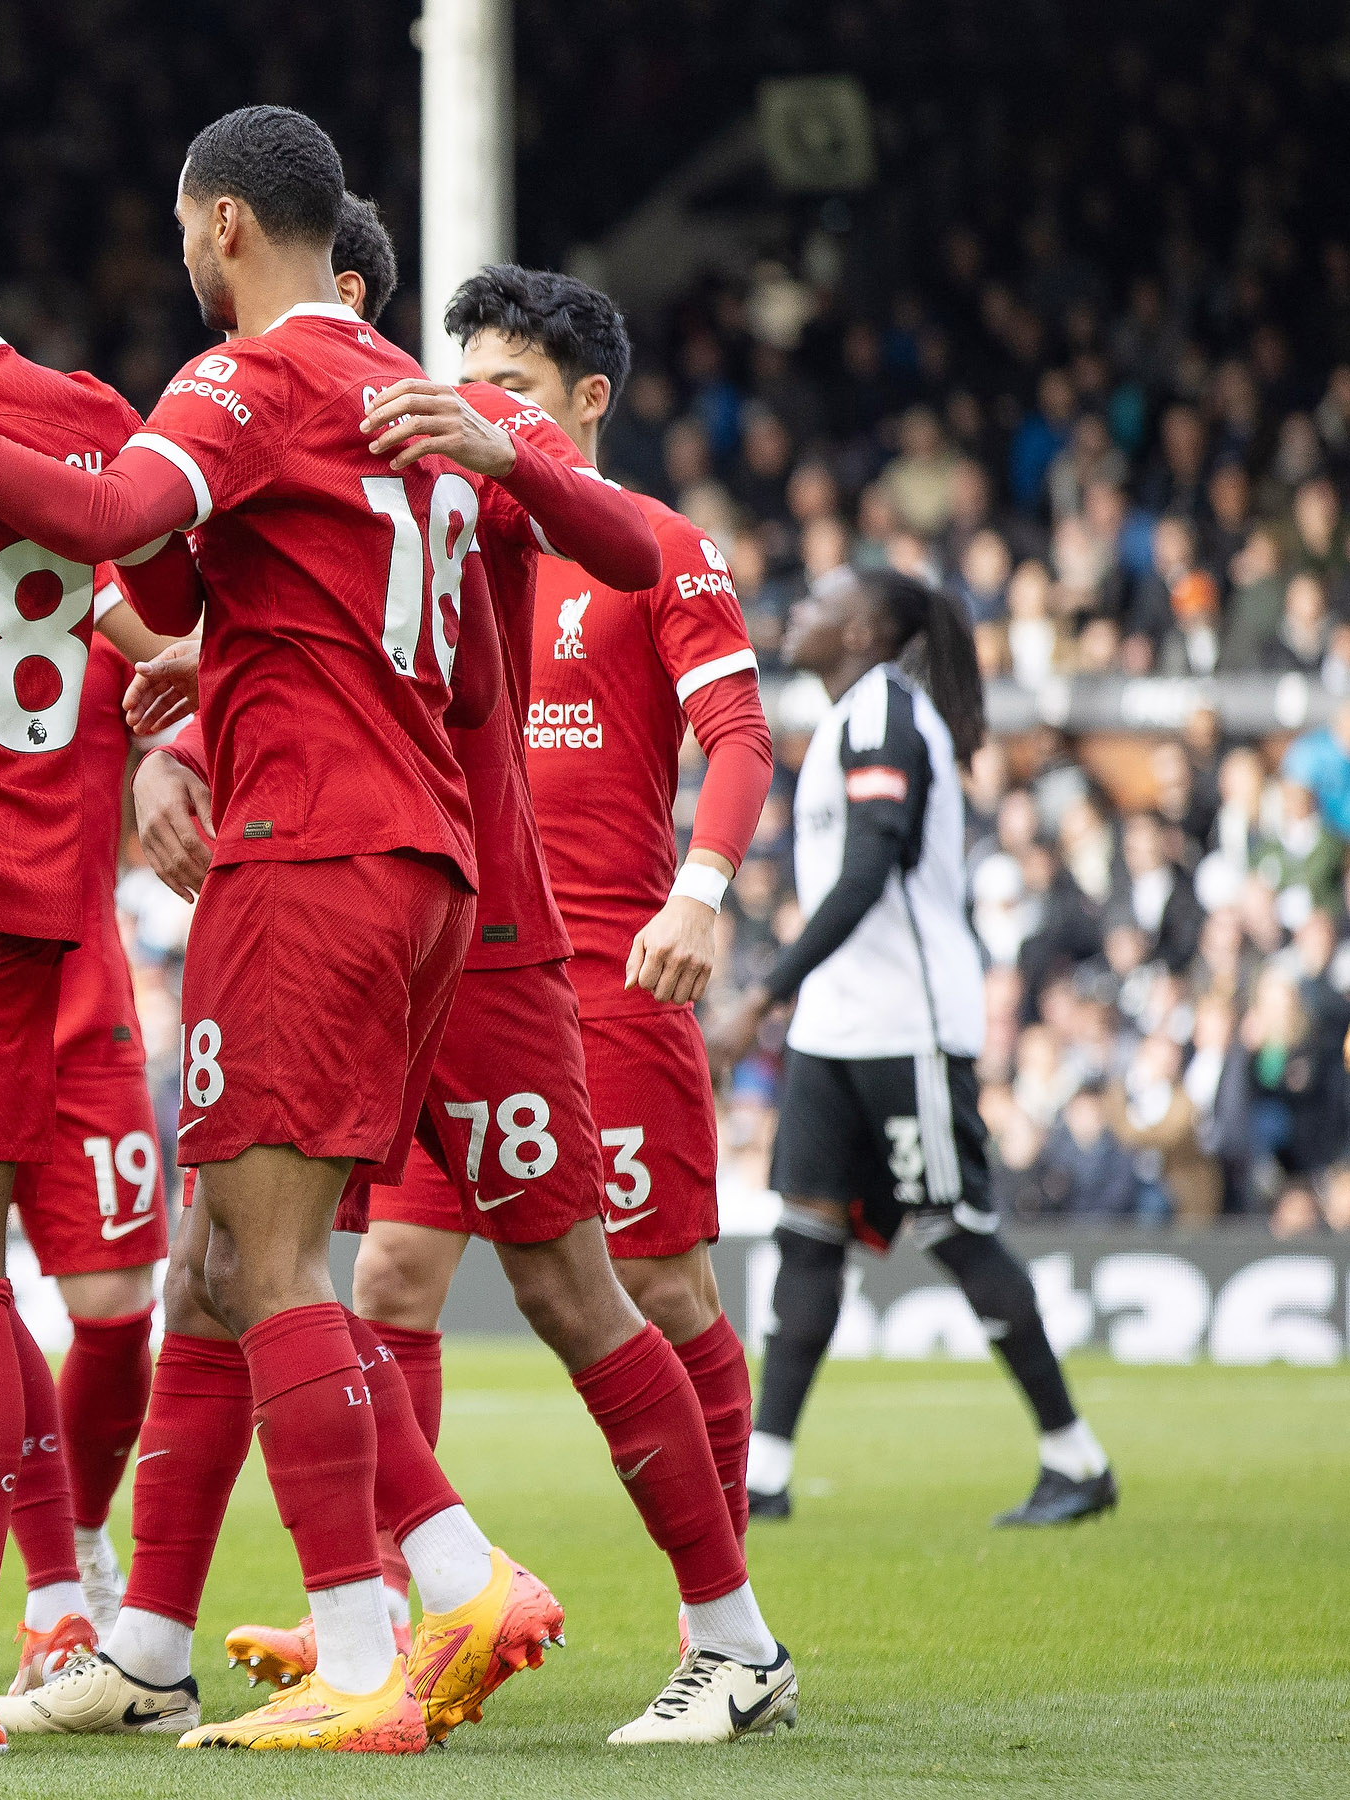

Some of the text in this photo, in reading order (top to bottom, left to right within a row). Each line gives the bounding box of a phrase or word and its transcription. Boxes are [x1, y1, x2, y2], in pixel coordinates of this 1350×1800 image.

[161, 379, 252, 426] xpedia
[360, 473, 479, 688] 18
[675, 572, 737, 600] Expe
[528, 698, 593, 725] dard
[83, 1131, 156, 1217] 19
[443, 1092, 558, 1182] 78
[601, 1126, 651, 1209] 3
